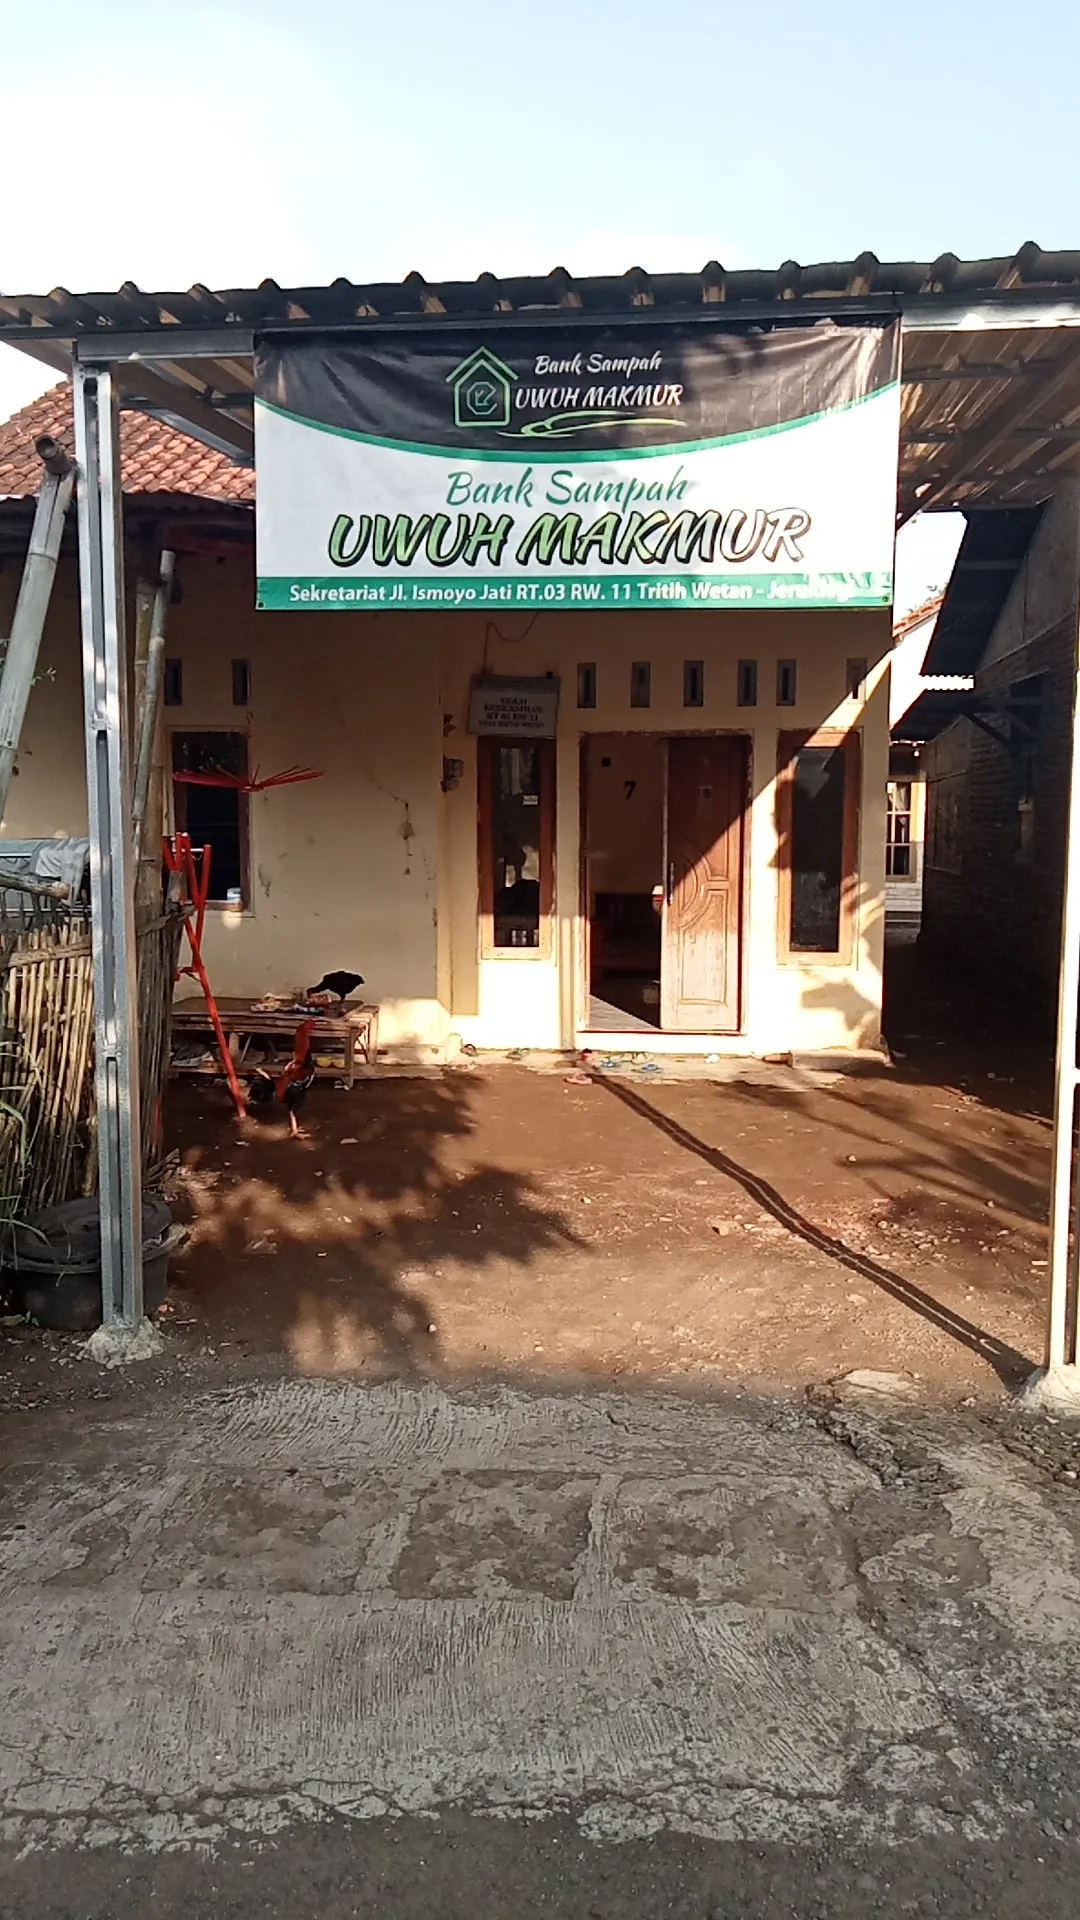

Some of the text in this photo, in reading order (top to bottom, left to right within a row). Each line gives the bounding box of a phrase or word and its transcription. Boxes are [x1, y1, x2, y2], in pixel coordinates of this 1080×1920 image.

[535, 350, 662, 378] Bank Sampah
[515, 384, 684, 409] UWUH MAKMUR
[446, 465, 688, 513] Bank Sampah
[328, 506, 812, 568] UWUH MAKMUR
[289, 584, 385, 602] Sekretariat
[388, 584, 408, 602] Jl.
[413, 584, 476, 605] Ismoyo
[479, 584, 512, 600] Jati
[516, 583, 565, 601] RT.03
[571, 583, 605, 600] RW.
[611, 582, 631, 599] 11
[637, 582, 687, 600] Tritih
[690, 582, 752, 600] Wetan
